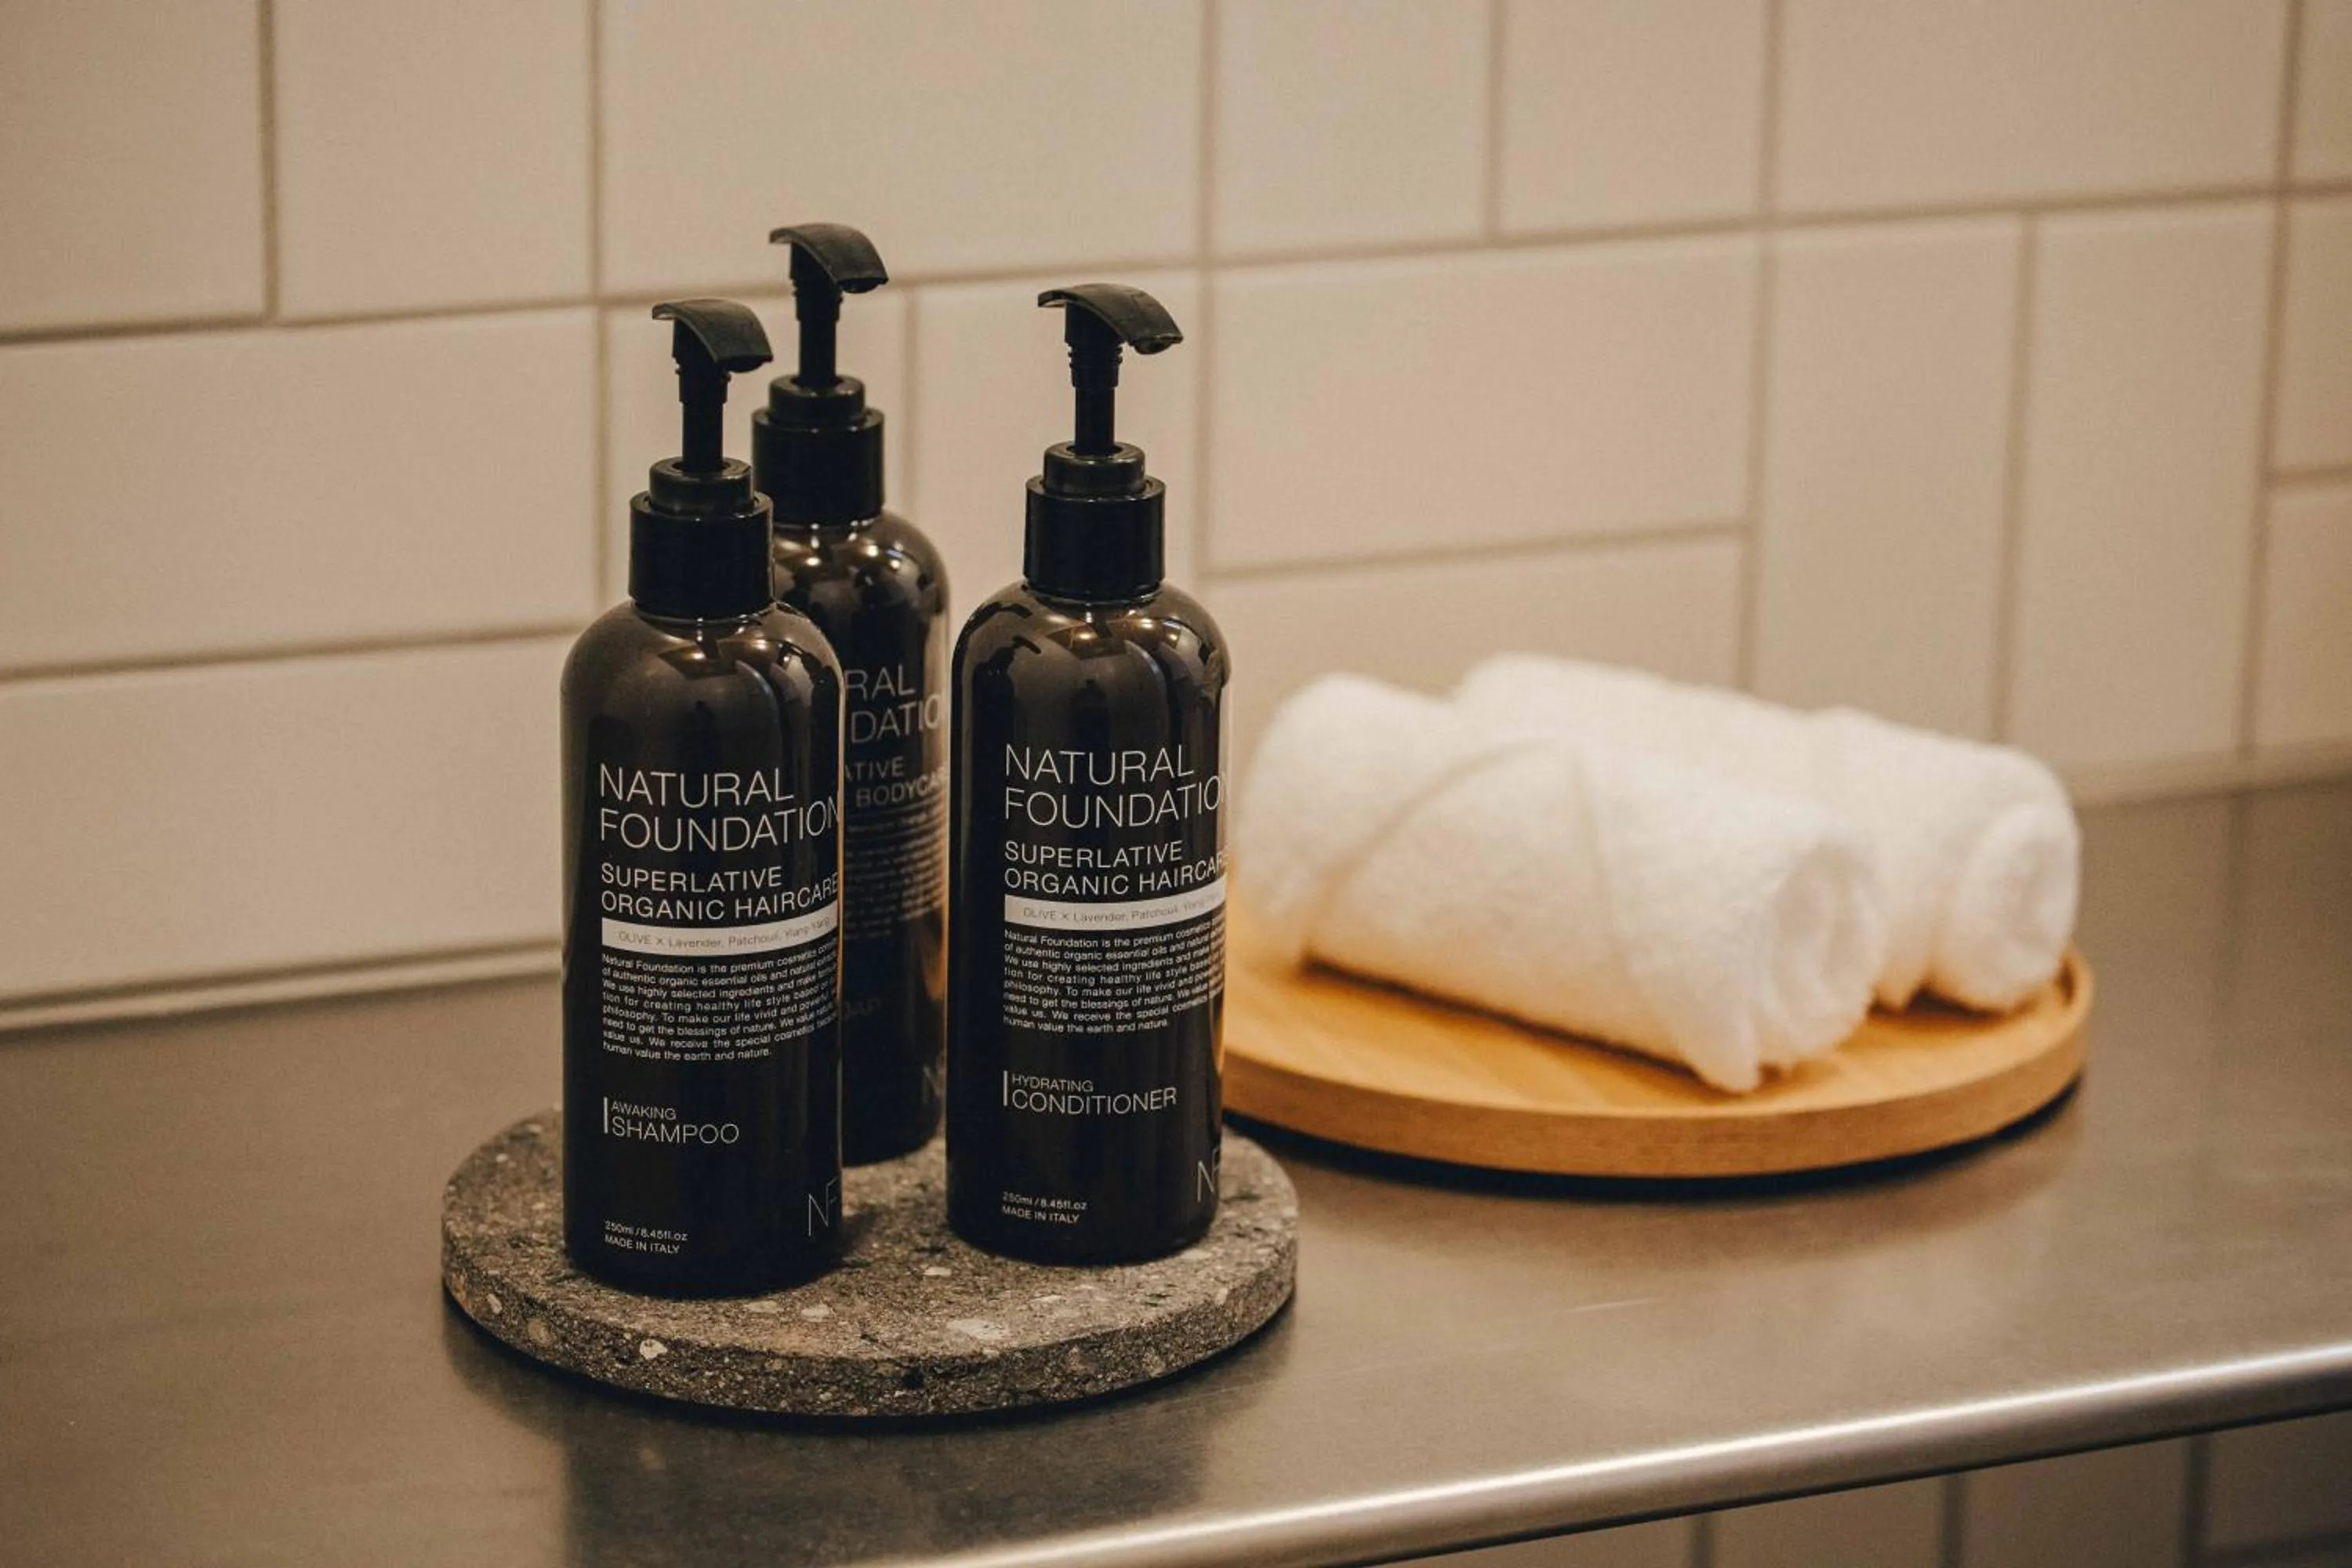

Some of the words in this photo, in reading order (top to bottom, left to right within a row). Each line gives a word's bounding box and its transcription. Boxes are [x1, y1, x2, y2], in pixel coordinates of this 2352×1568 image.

[1006, 743, 1194, 785] NATURAL
[601, 763, 794, 808] NATURAL
[1005, 775, 1221, 829] FOUNDATIO
[1004, 840, 1183, 869] SUPERLATIVE
[601, 862, 782, 893] SUPERLATIVE
[1004, 868, 1129, 895] ORGANIC
[601, 890, 725, 920] ORGANIC
[735, 871, 839, 918] HAIRCARE
[1004, 929, 1037, 943] Natural
[1040, 935, 1098, 947] Foundation
[1114, 938, 1130, 947] the
[1133, 933, 1174, 947] premium
[1004, 942, 1013, 951] of
[1015, 946, 1061, 958] authentic
[1064, 951, 1102, 961] organic
[1152, 946, 1167, 956] oils
[1169, 942, 1186, 953] and
[602, 953, 633, 968] Natural
[636, 960, 694, 973] Foundation
[698, 965, 706, 974] is
[710, 964, 727, 974] the
[731, 960, 774, 973] premium
[1022, 960, 1039, 968] use
[1042, 960, 1072, 973] highly
[1075, 964, 1119, 973] selected
[1122, 957, 1174, 973] ingredients
[602, 967, 611, 977] of
[613, 970, 656, 984] authentic
[659, 977, 699, 987] organic
[702, 975, 747, 985] essential
[750, 972, 768, 983] oils
[770, 970, 788, 981] and
[1028, 971, 1043, 981] for
[1047, 975, 1095, 986] creating
[1100, 974, 1142, 985] healthy
[1145, 971, 1161, 981] life
[619, 985, 635, 993] use
[637, 986, 667, 999] highly
[671, 989, 716, 998] selected
[719, 984, 775, 1000] ingredients
[777, 980, 794, 992] and
[1066, 986, 1078, 996] To
[1082, 987, 1112, 996] make
[624, 996, 638, 1006] for
[644, 1000, 691, 1013] creating
[696, 1000, 740, 1012] healthy
[744, 999, 762, 1008] life
[766, 994, 791, 1006] style
[1029, 996, 1039, 1004] to
[1042, 998, 1058, 1008] get
[1061, 999, 1078, 1008] the
[1082, 1000, 1129, 1010] blessings
[1131, 997, 1142, 1007] of
[661, 1012, 674, 1023] To
[678, 1014, 710, 1023] make
[713, 1015, 731, 1024] our
[735, 1011, 751, 1021] life
[753, 1008, 778, 1019] vivid
[780, 1004, 797, 1016] and
[1051, 1010, 1069, 1020] We
[1116, 1011, 1132, 1019] the
[626, 1022, 636, 1031] to
[638, 1024, 655, 1034] get
[658, 1025, 675, 1035] the
[677, 1026, 727, 1038] blessings
[730, 1024, 740, 1036] of
[780, 1017, 794, 1028] We
[1116, 1023, 1135, 1032] and
[603, 1040, 632, 1055] human
[634, 1048, 661, 1059] value
[664, 1051, 681, 1061] the
[684, 1051, 711, 1061] earth
[714, 1051, 735, 1060] and
[648, 1036, 666, 1047] We
[670, 1040, 708, 1048] receive
[713, 1039, 730, 1048] the
[735, 1035, 771, 1047] special
[1011, 1073, 1094, 1092] HYDRATING
[611, 1100, 677, 1120] AWAKING
[1012, 1087, 1177, 1115] CONDITIONER
[612, 1116, 739, 1145] SHAMPOO
[1002, 1205, 1033, 1220] MADE
[1035, 1211, 1047, 1221] IN
[1049, 1213, 1080, 1224] ITALY
[604, 1234, 633, 1249] MADE
[636, 1241, 647, 1252] IN
[650, 1243, 680, 1254] ITALY
